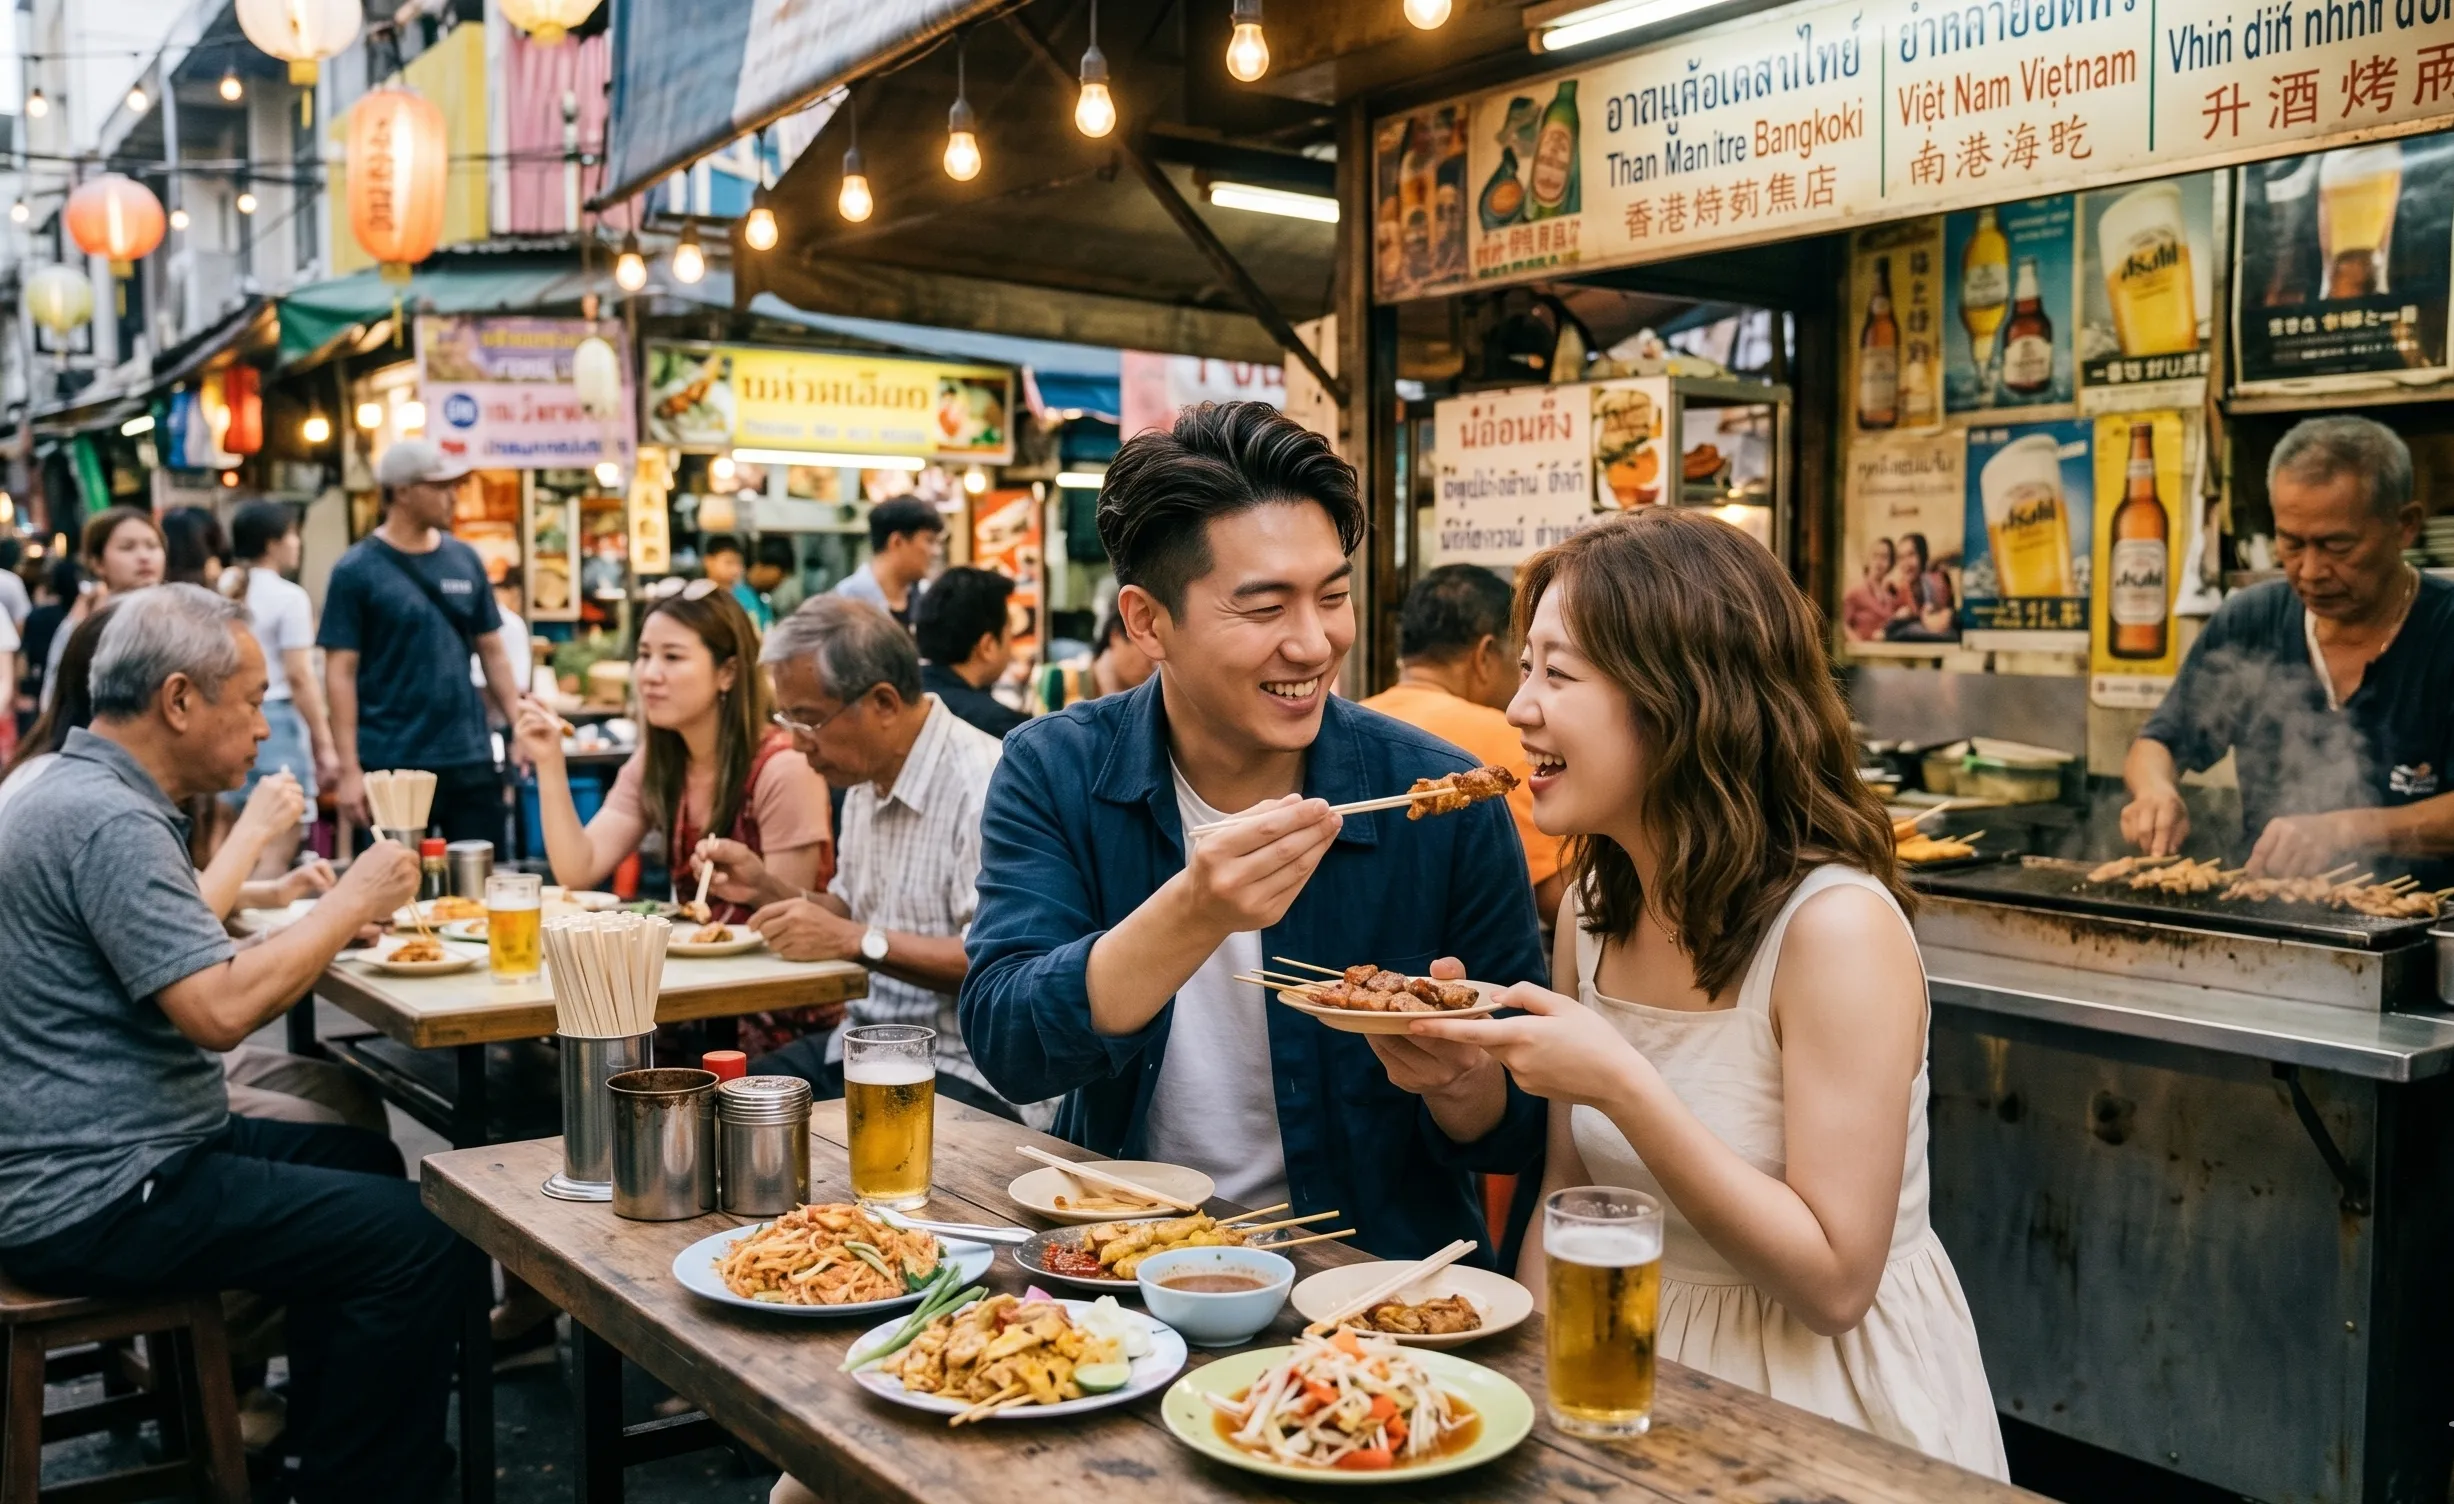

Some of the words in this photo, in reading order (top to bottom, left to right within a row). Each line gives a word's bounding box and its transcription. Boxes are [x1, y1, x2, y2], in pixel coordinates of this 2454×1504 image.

[1898, 80, 1945, 132] Việt
[1954, 73, 2010, 116] Nam
[1607, 152, 1657, 188] Than
[1755, 97, 1863, 159] Bangkoki
